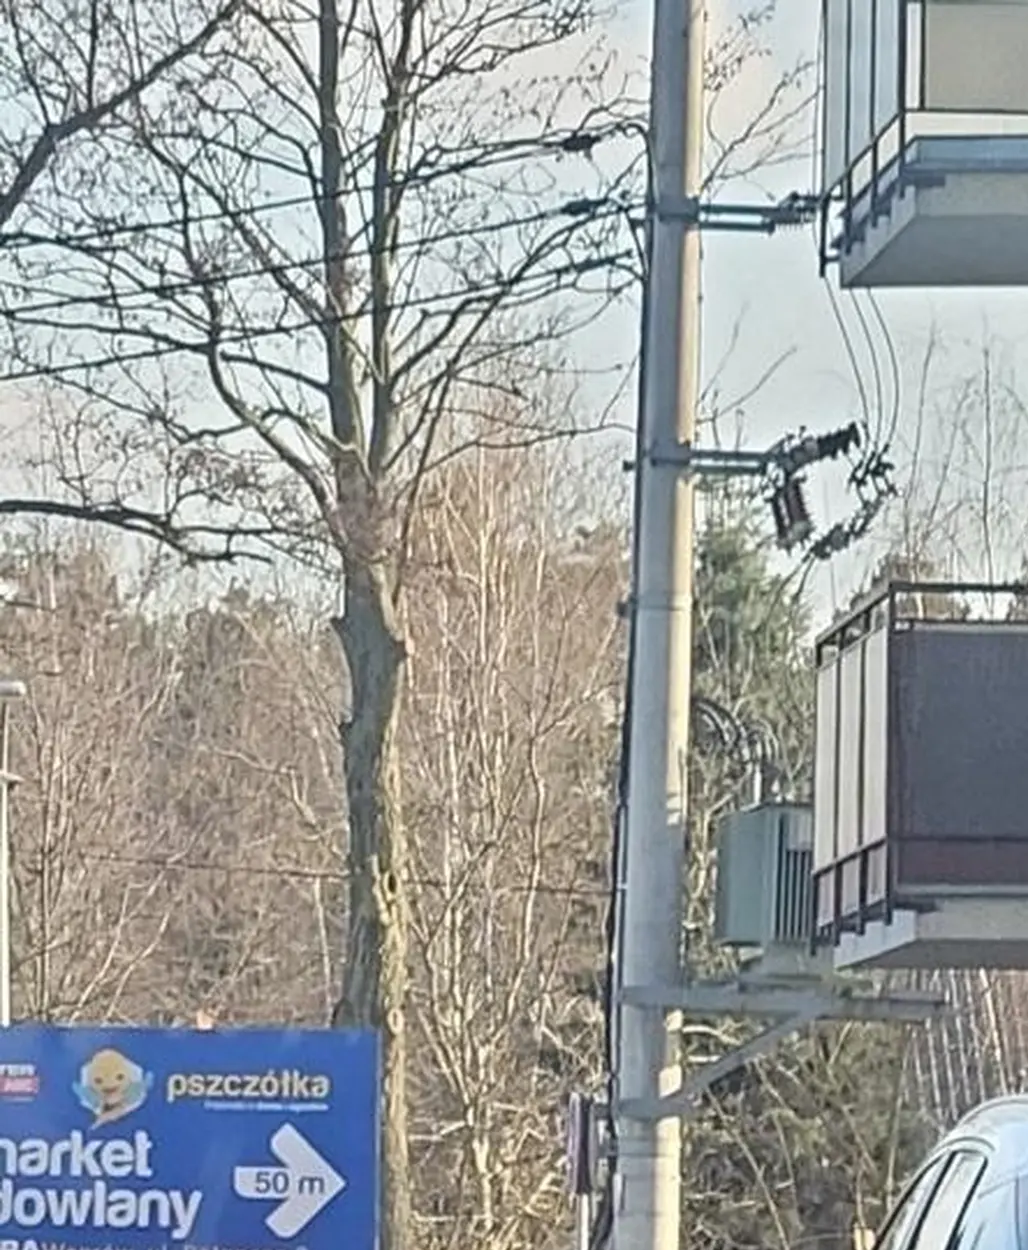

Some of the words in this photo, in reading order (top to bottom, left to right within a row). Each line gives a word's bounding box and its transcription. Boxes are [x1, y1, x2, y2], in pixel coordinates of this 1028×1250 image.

[167, 1069, 330, 1102] pszczółka
[256, 1171, 290, 1194] 50
[298, 1176, 325, 1195] m
